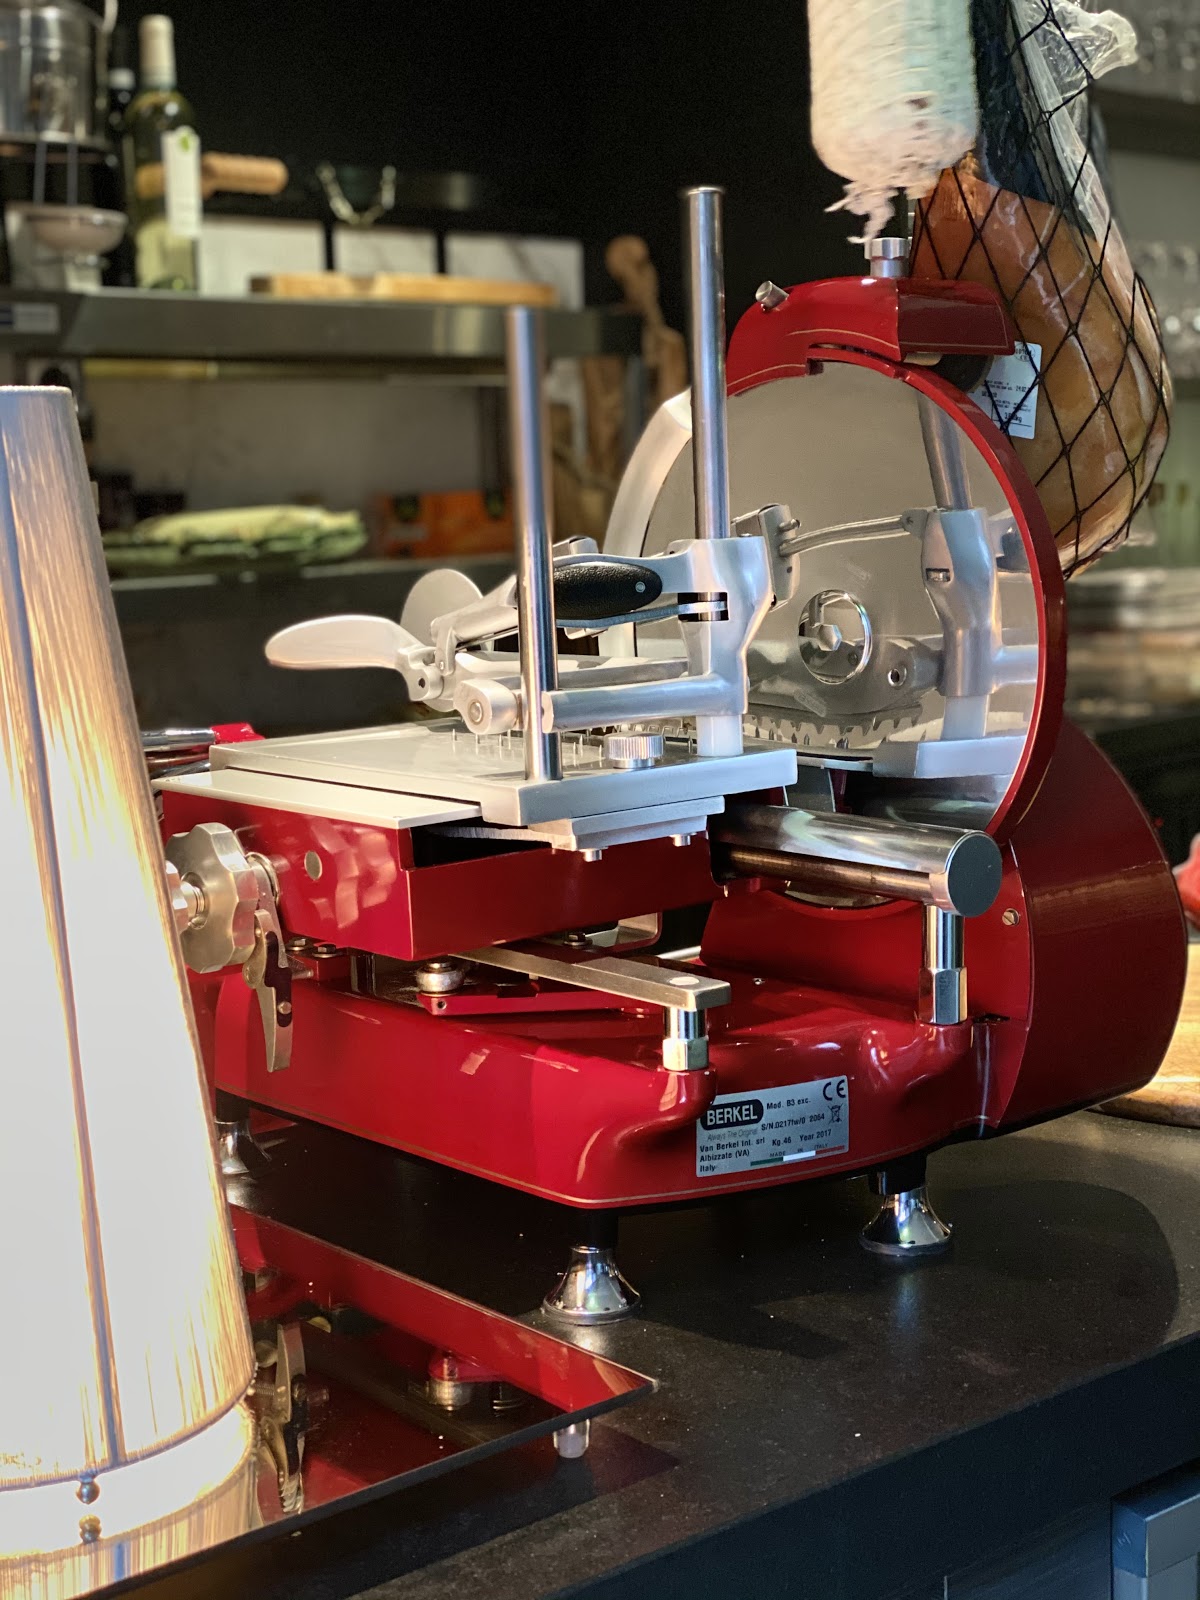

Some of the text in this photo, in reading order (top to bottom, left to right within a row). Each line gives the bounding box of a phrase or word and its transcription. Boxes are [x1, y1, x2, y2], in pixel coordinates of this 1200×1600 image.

[766, 1101, 784, 1110] Mod.
[787, 1099, 796, 1107] B3
[707, 1105, 757, 1126] BERKEL
[727, 1130, 738, 1138] The
[700, 1145, 714, 1153] Van
[716, 1140, 739, 1150] Berkel
[755, 1136, 765, 1145] srl
[799, 1133, 815, 1142] Year
[816, 1129, 832, 1138] 2017
[700, 1148, 750, 1162] Albizzate (VA)
[699, 1164, 716, 1173] Italy
